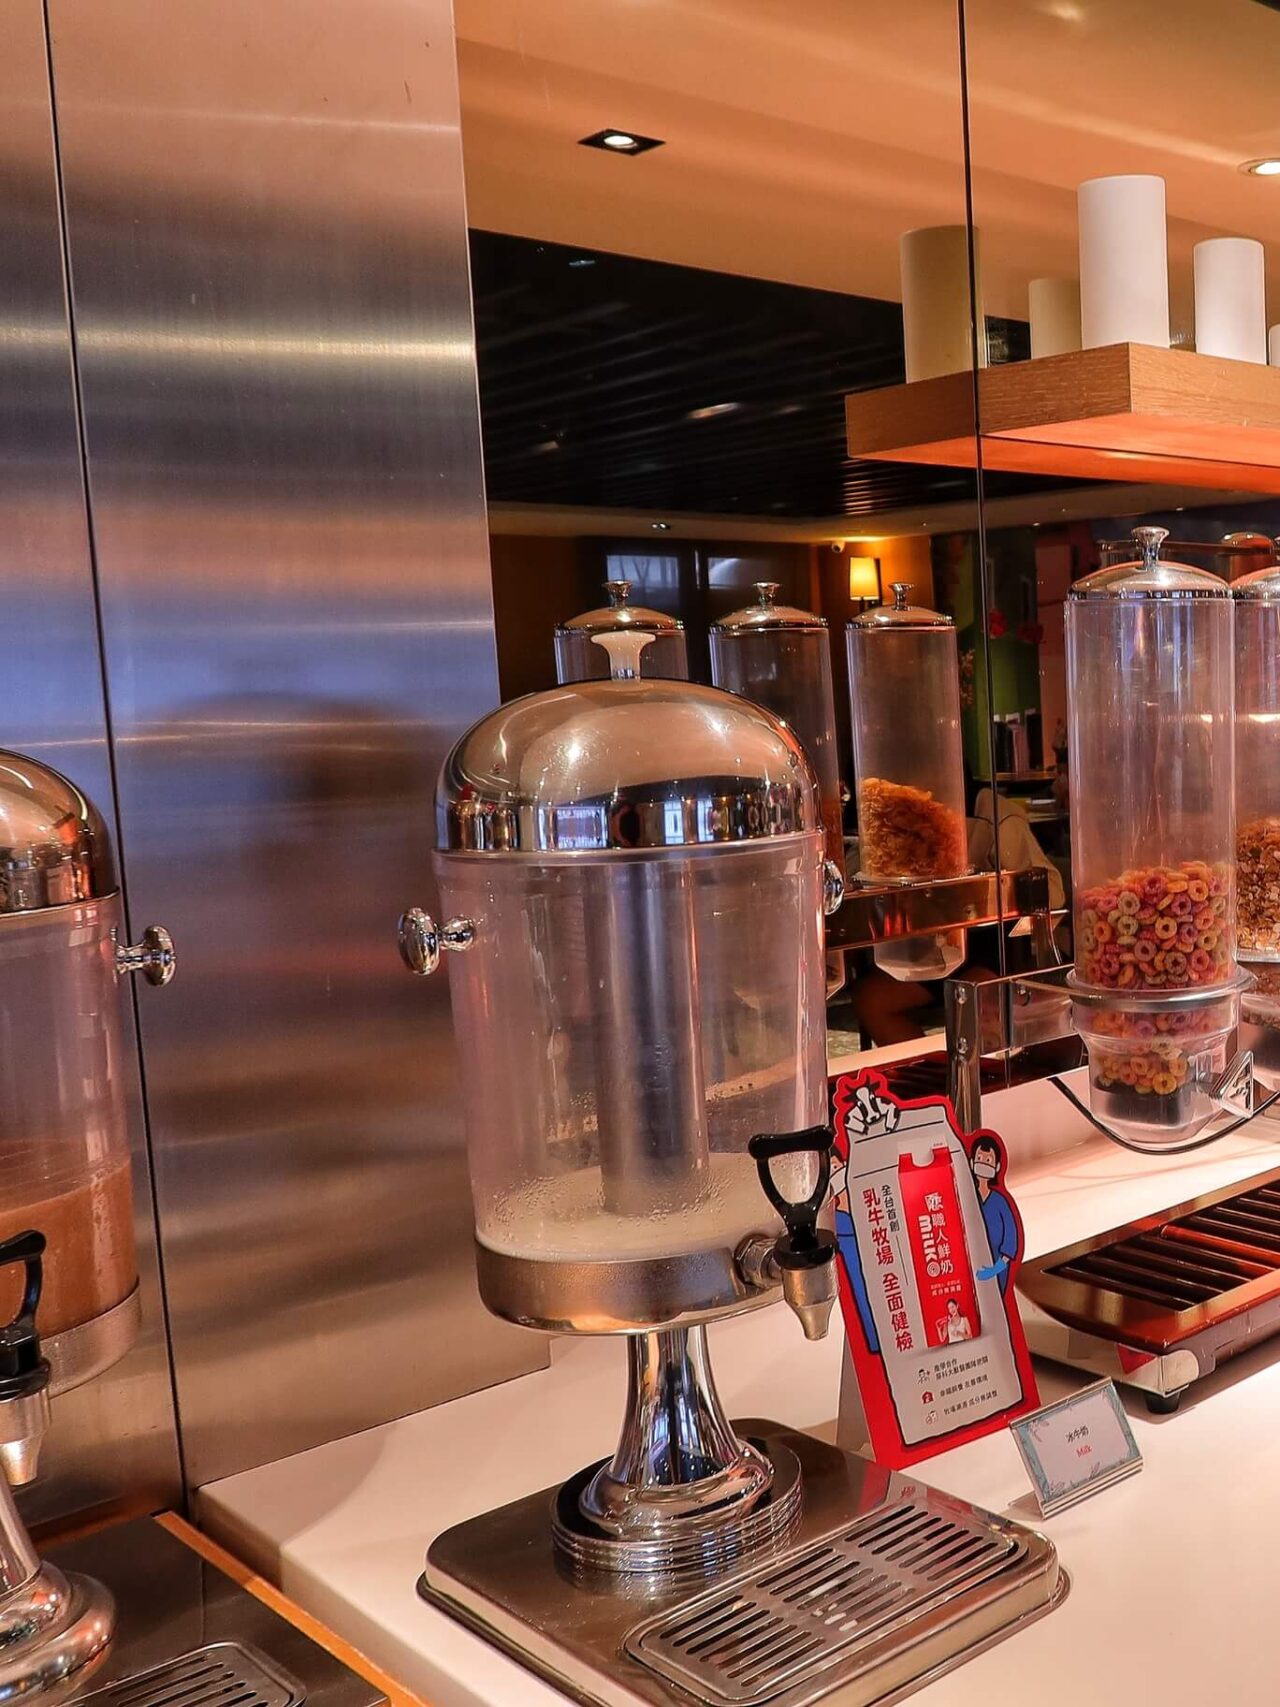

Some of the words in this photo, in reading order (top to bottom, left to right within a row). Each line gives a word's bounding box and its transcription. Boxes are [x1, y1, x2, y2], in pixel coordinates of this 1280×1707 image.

[881, 1184, 899, 1232] 全台首創
[863, 1187, 894, 1267] 乳牛牧場
[883, 1272, 913, 1352] 全面健檢
